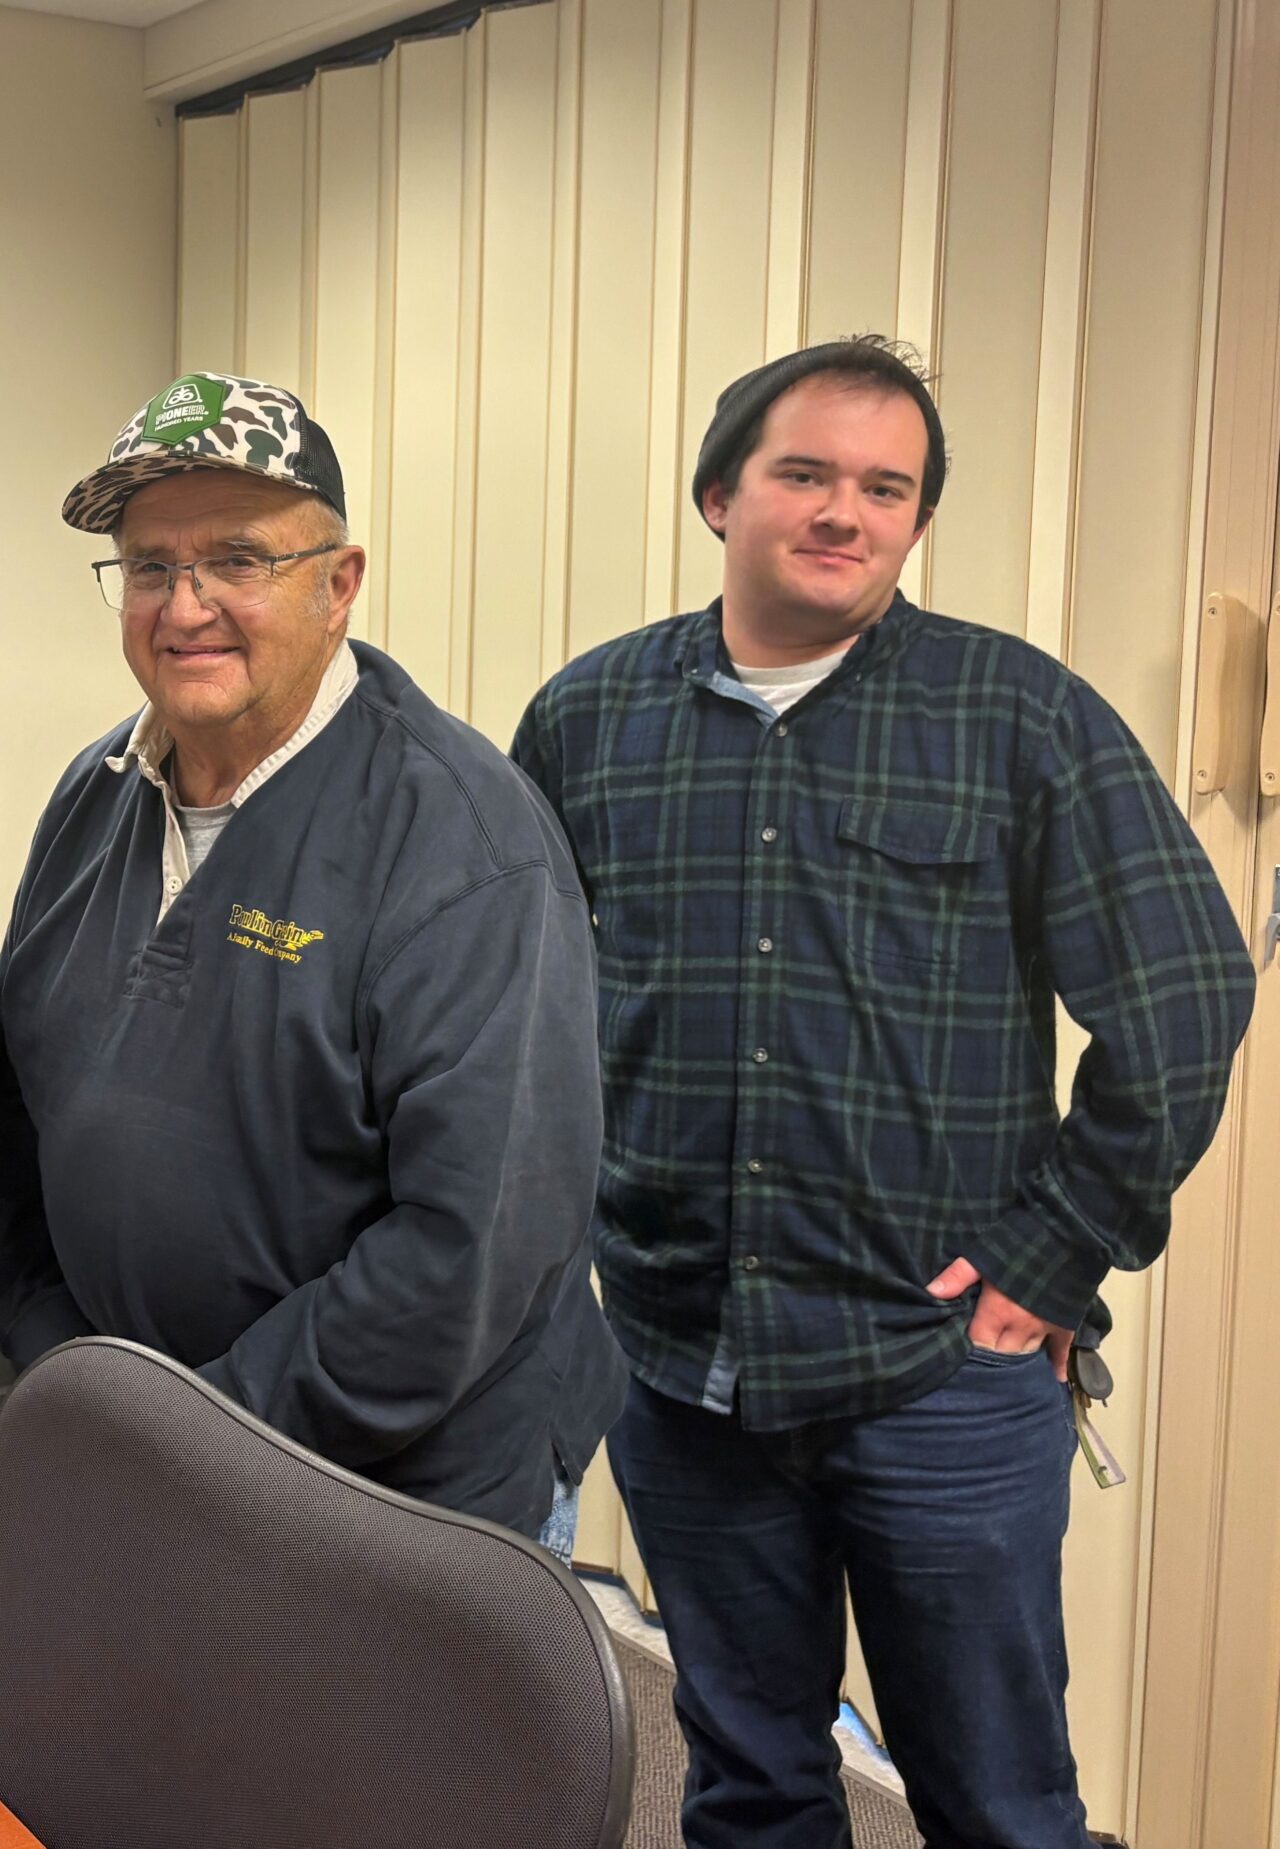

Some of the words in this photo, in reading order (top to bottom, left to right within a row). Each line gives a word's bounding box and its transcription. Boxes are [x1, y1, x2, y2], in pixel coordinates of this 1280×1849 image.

[155, 405, 205, 425] PIONEER
[255, 940, 273, 956] Feed
[273, 947, 302, 964] Cmpany
